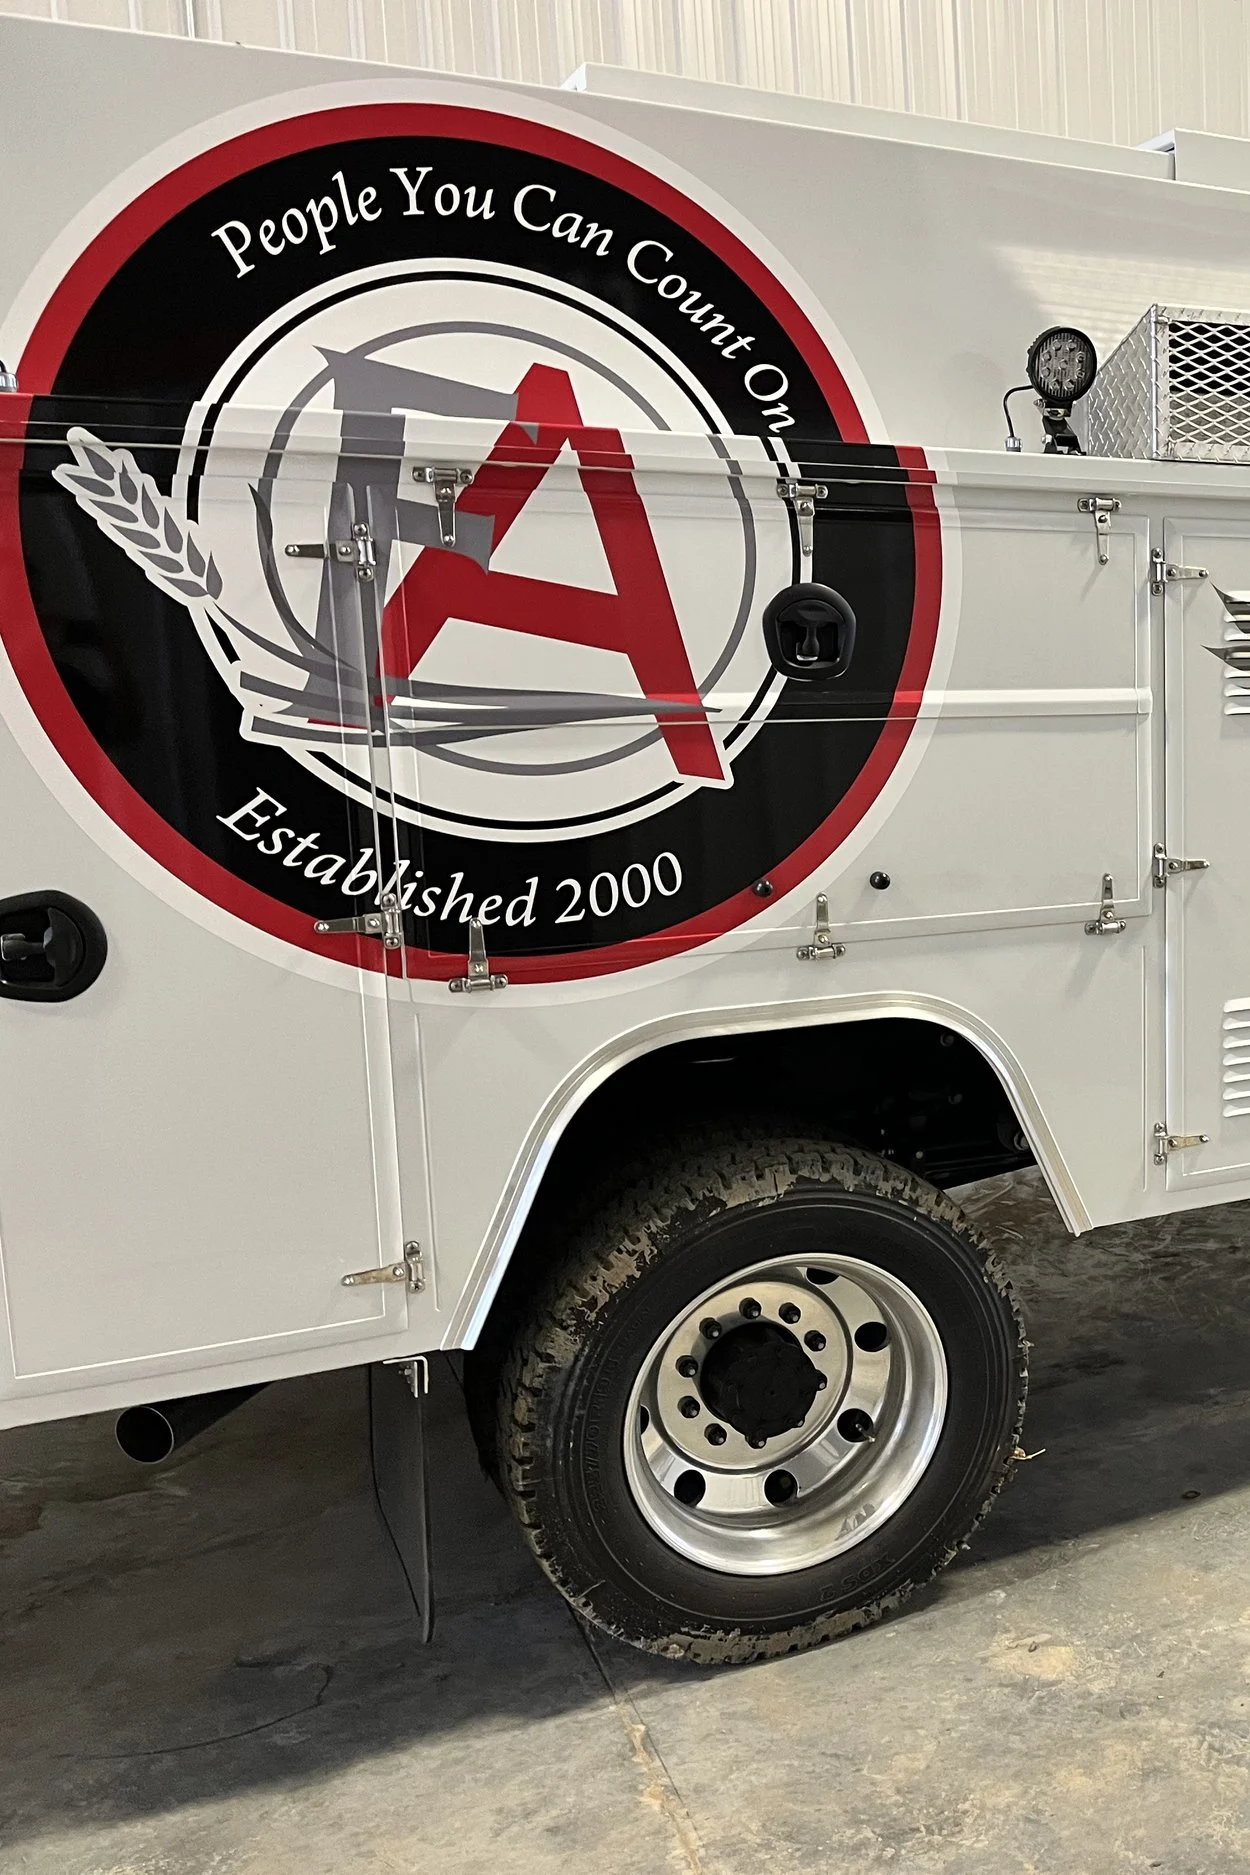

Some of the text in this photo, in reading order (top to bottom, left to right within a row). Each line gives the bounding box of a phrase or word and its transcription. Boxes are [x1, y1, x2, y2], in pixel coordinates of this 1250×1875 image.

[210, 166, 796, 433] People You Can Count On
[215, 786, 683, 928] Established 2000
